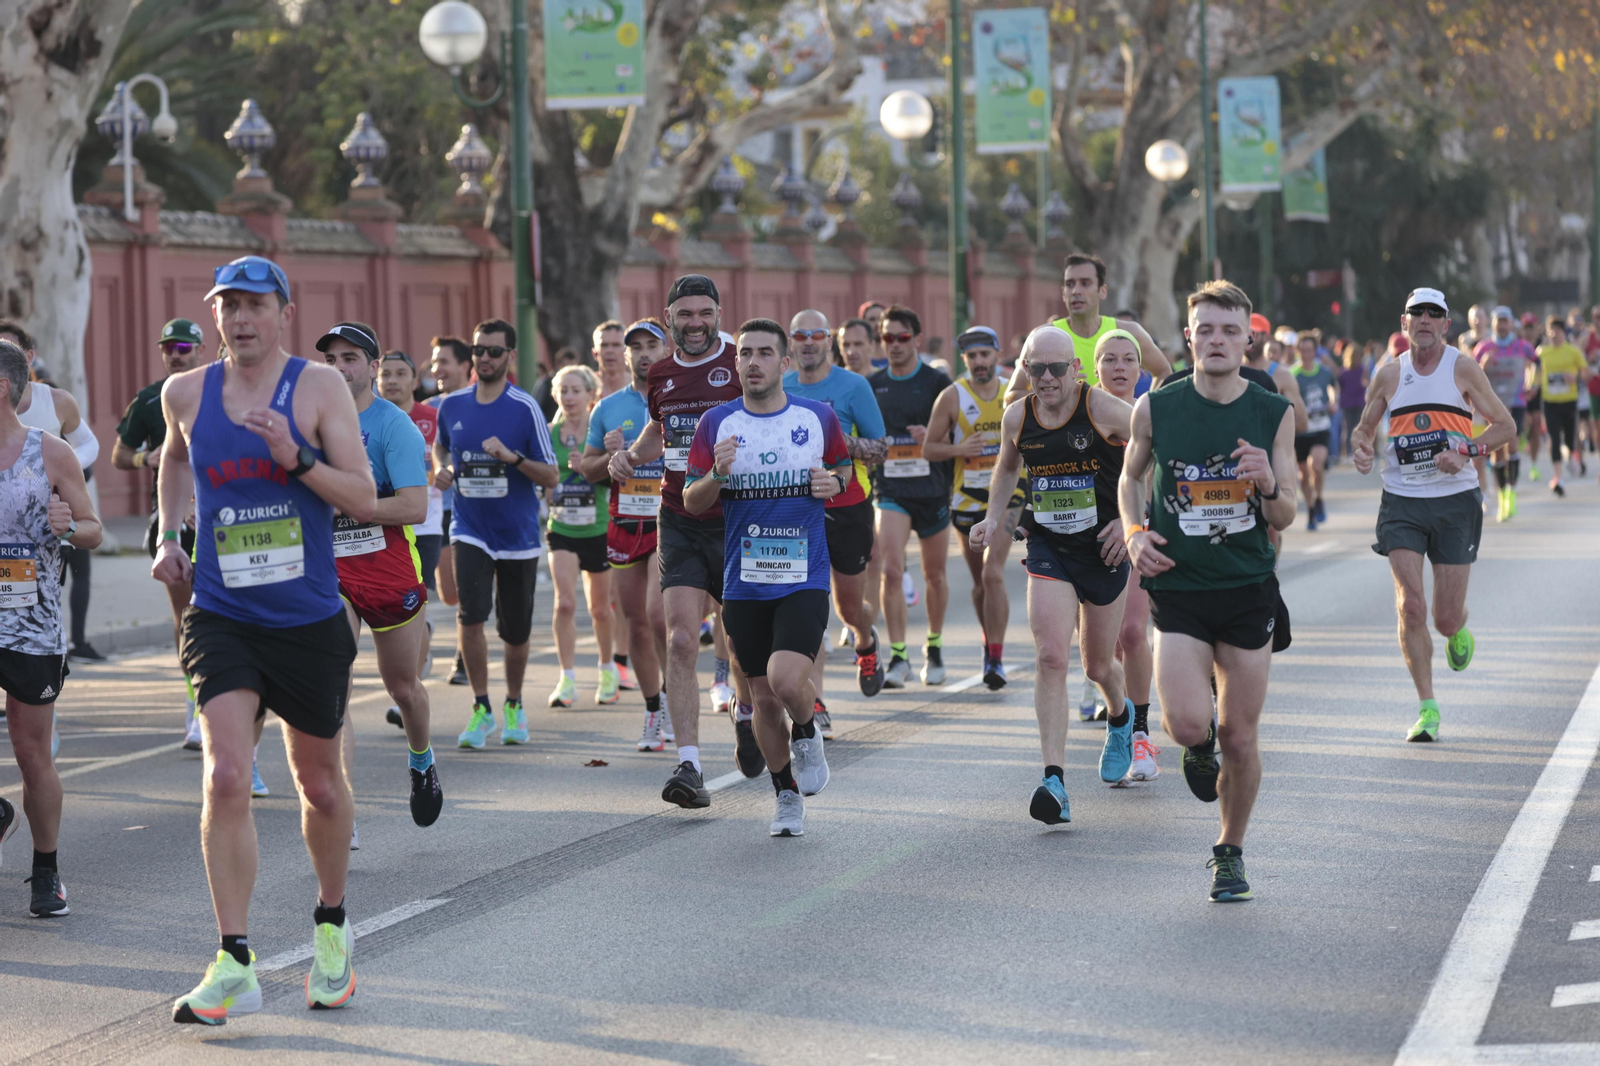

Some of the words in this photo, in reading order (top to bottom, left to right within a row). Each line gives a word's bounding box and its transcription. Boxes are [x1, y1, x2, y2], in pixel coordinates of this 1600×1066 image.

[1410, 432, 1440, 445] ZURICH
[758, 452, 778, 465] 10
[1413, 449, 1432, 460] 3157
[206, 458, 288, 490] ARENA
[1030, 462, 1079, 476] ACKROCK
[1051, 479, 1085, 488] ZURICH
[742, 486, 809, 499] ANIVERSARIO
[1204, 490, 1230, 500] 4989
[1053, 498, 1073, 507] 1323
[238, 504, 288, 521] ZURICH
[1053, 512, 1076, 521] BARRY
[1202, 507, 1234, 517] 300896
[354, 530, 372, 539] ALBA
[762, 528, 800, 536] ZURICH
[242, 533, 272, 547] 1138
[760, 546, 788, 556] 11700
[249, 554, 268, 565] KEV
